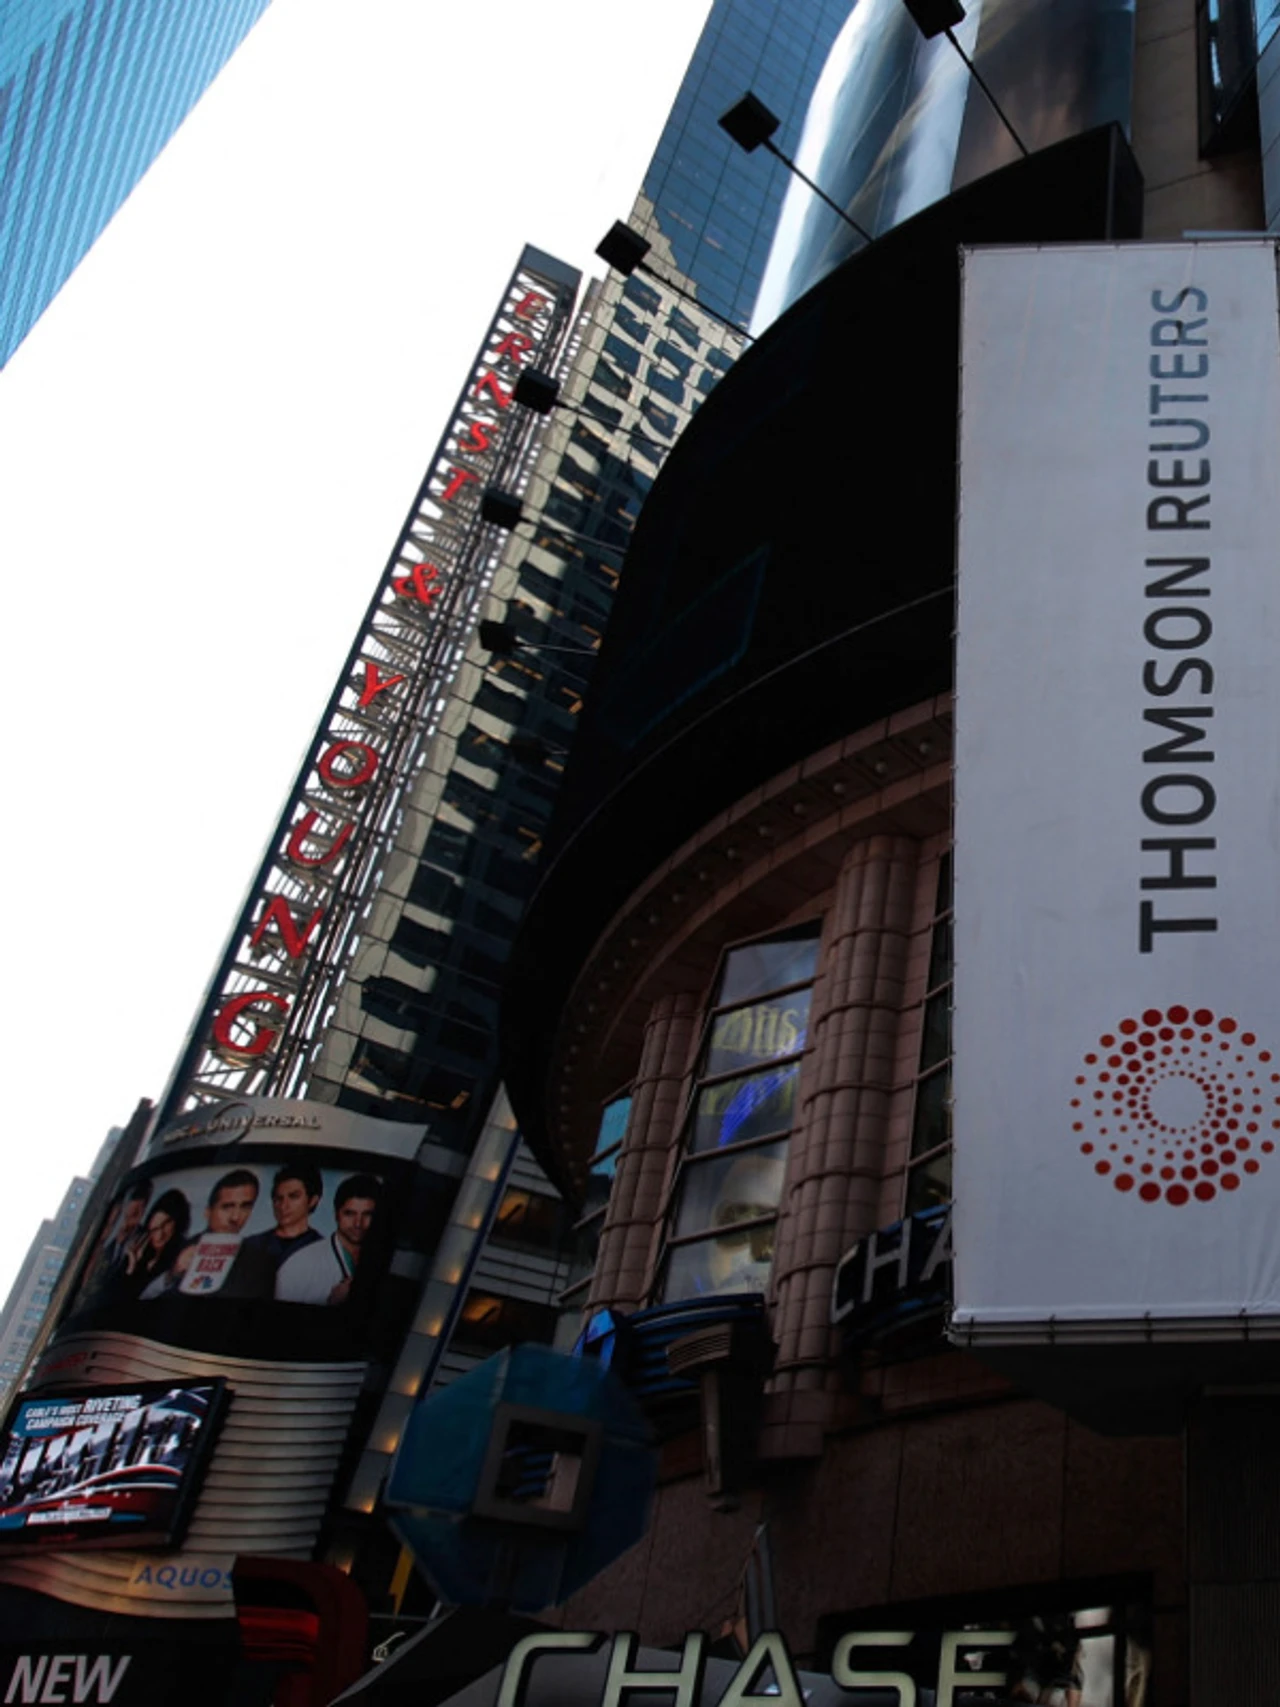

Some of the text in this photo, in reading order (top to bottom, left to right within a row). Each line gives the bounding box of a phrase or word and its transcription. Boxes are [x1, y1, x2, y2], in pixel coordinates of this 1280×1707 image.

[1139, 286, 1217, 953] THOMSON REUTERS
[212, 291, 547, 1055] ERNST & YOUNG
[206, 1114, 322, 1133] UNIVERSAL
[3, 1655, 132, 1704] NEW
[498, 1631, 1020, 1707] CHASE
